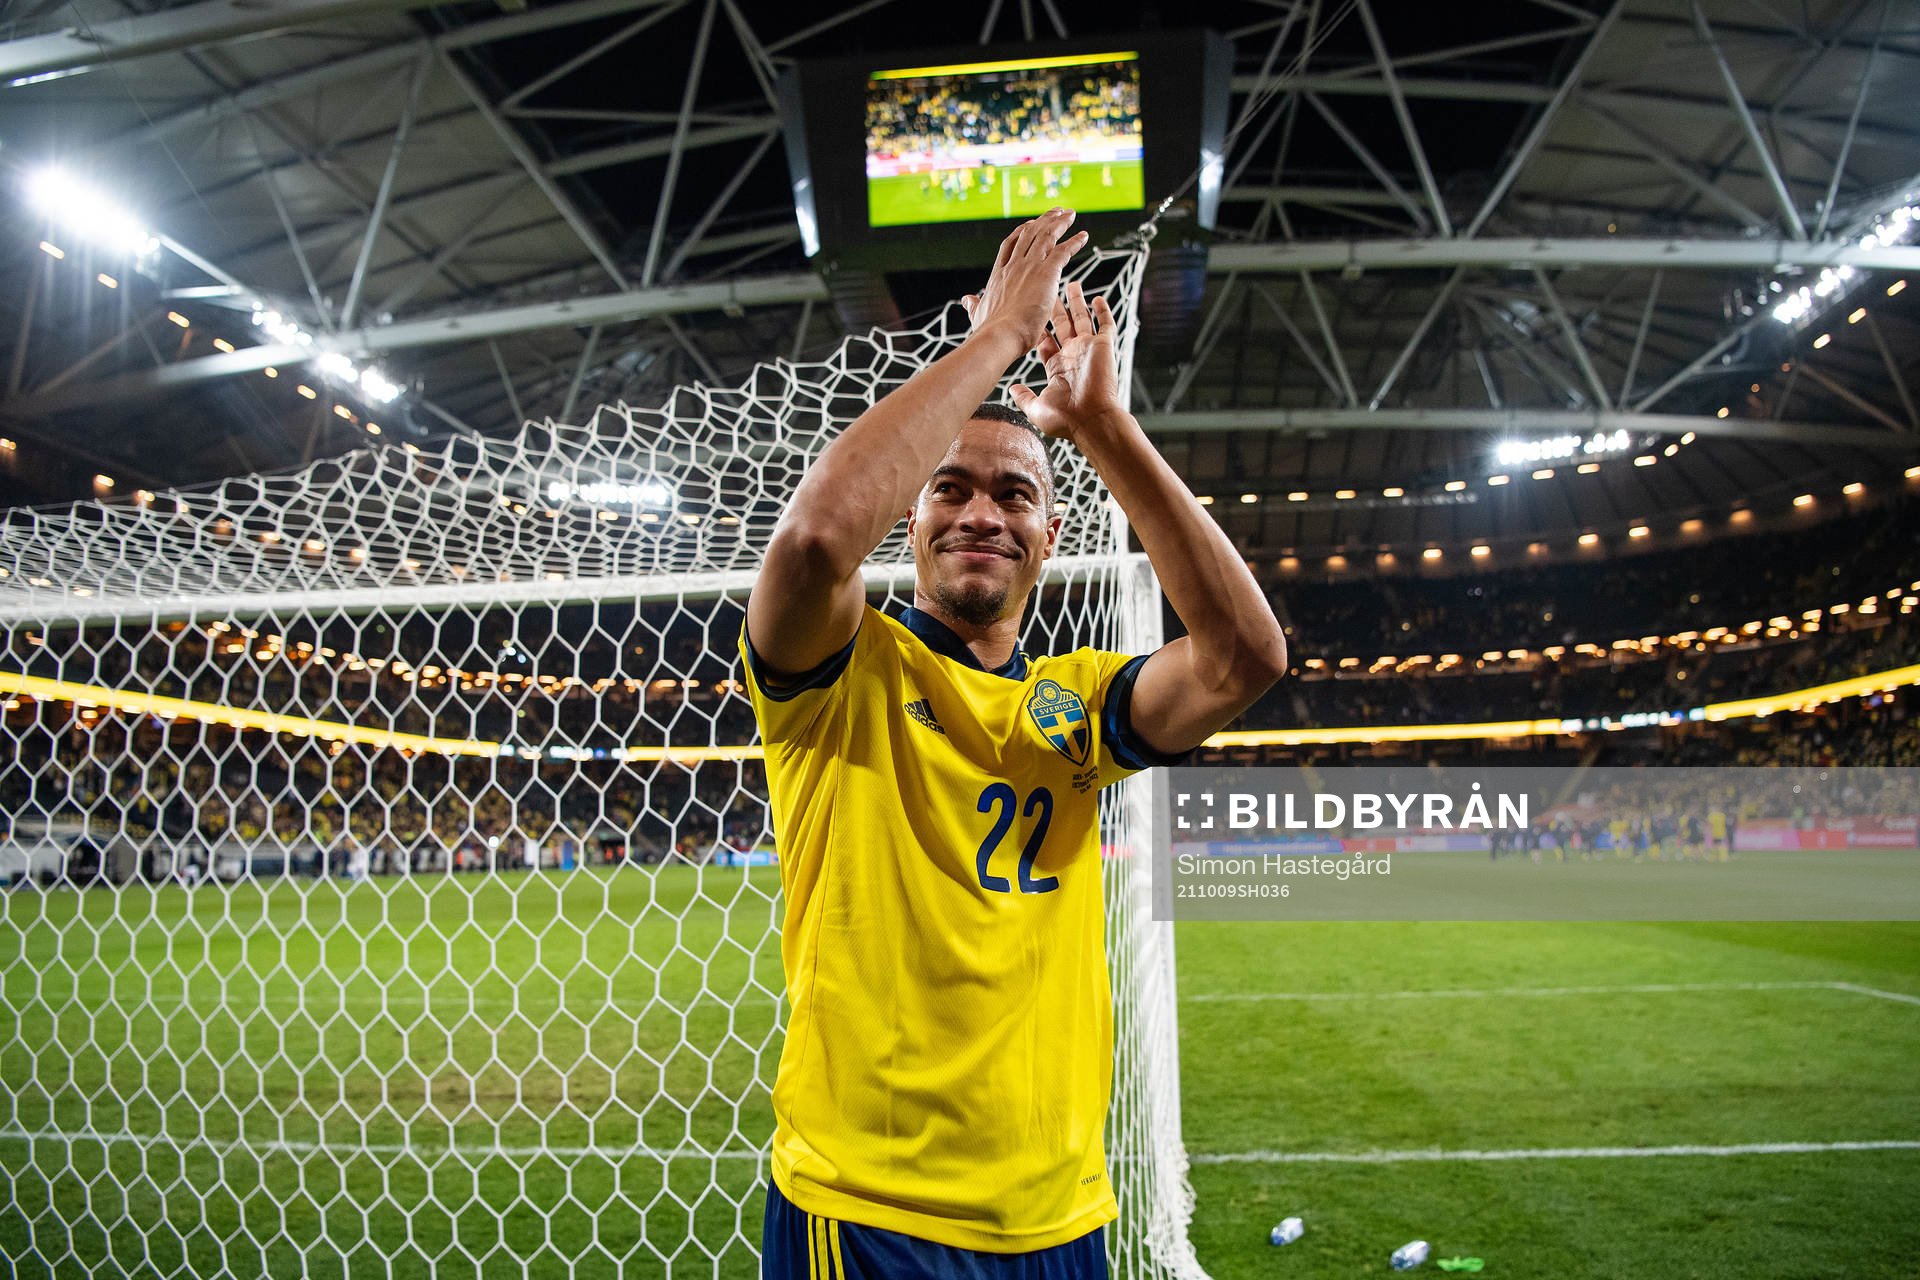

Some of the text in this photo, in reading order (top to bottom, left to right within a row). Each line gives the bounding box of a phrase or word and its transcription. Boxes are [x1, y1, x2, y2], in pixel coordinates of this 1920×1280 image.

[904, 703, 945, 734] adidas
[1038, 701, 1075, 715] SVERIGE
[976, 782, 1060, 894] 22
